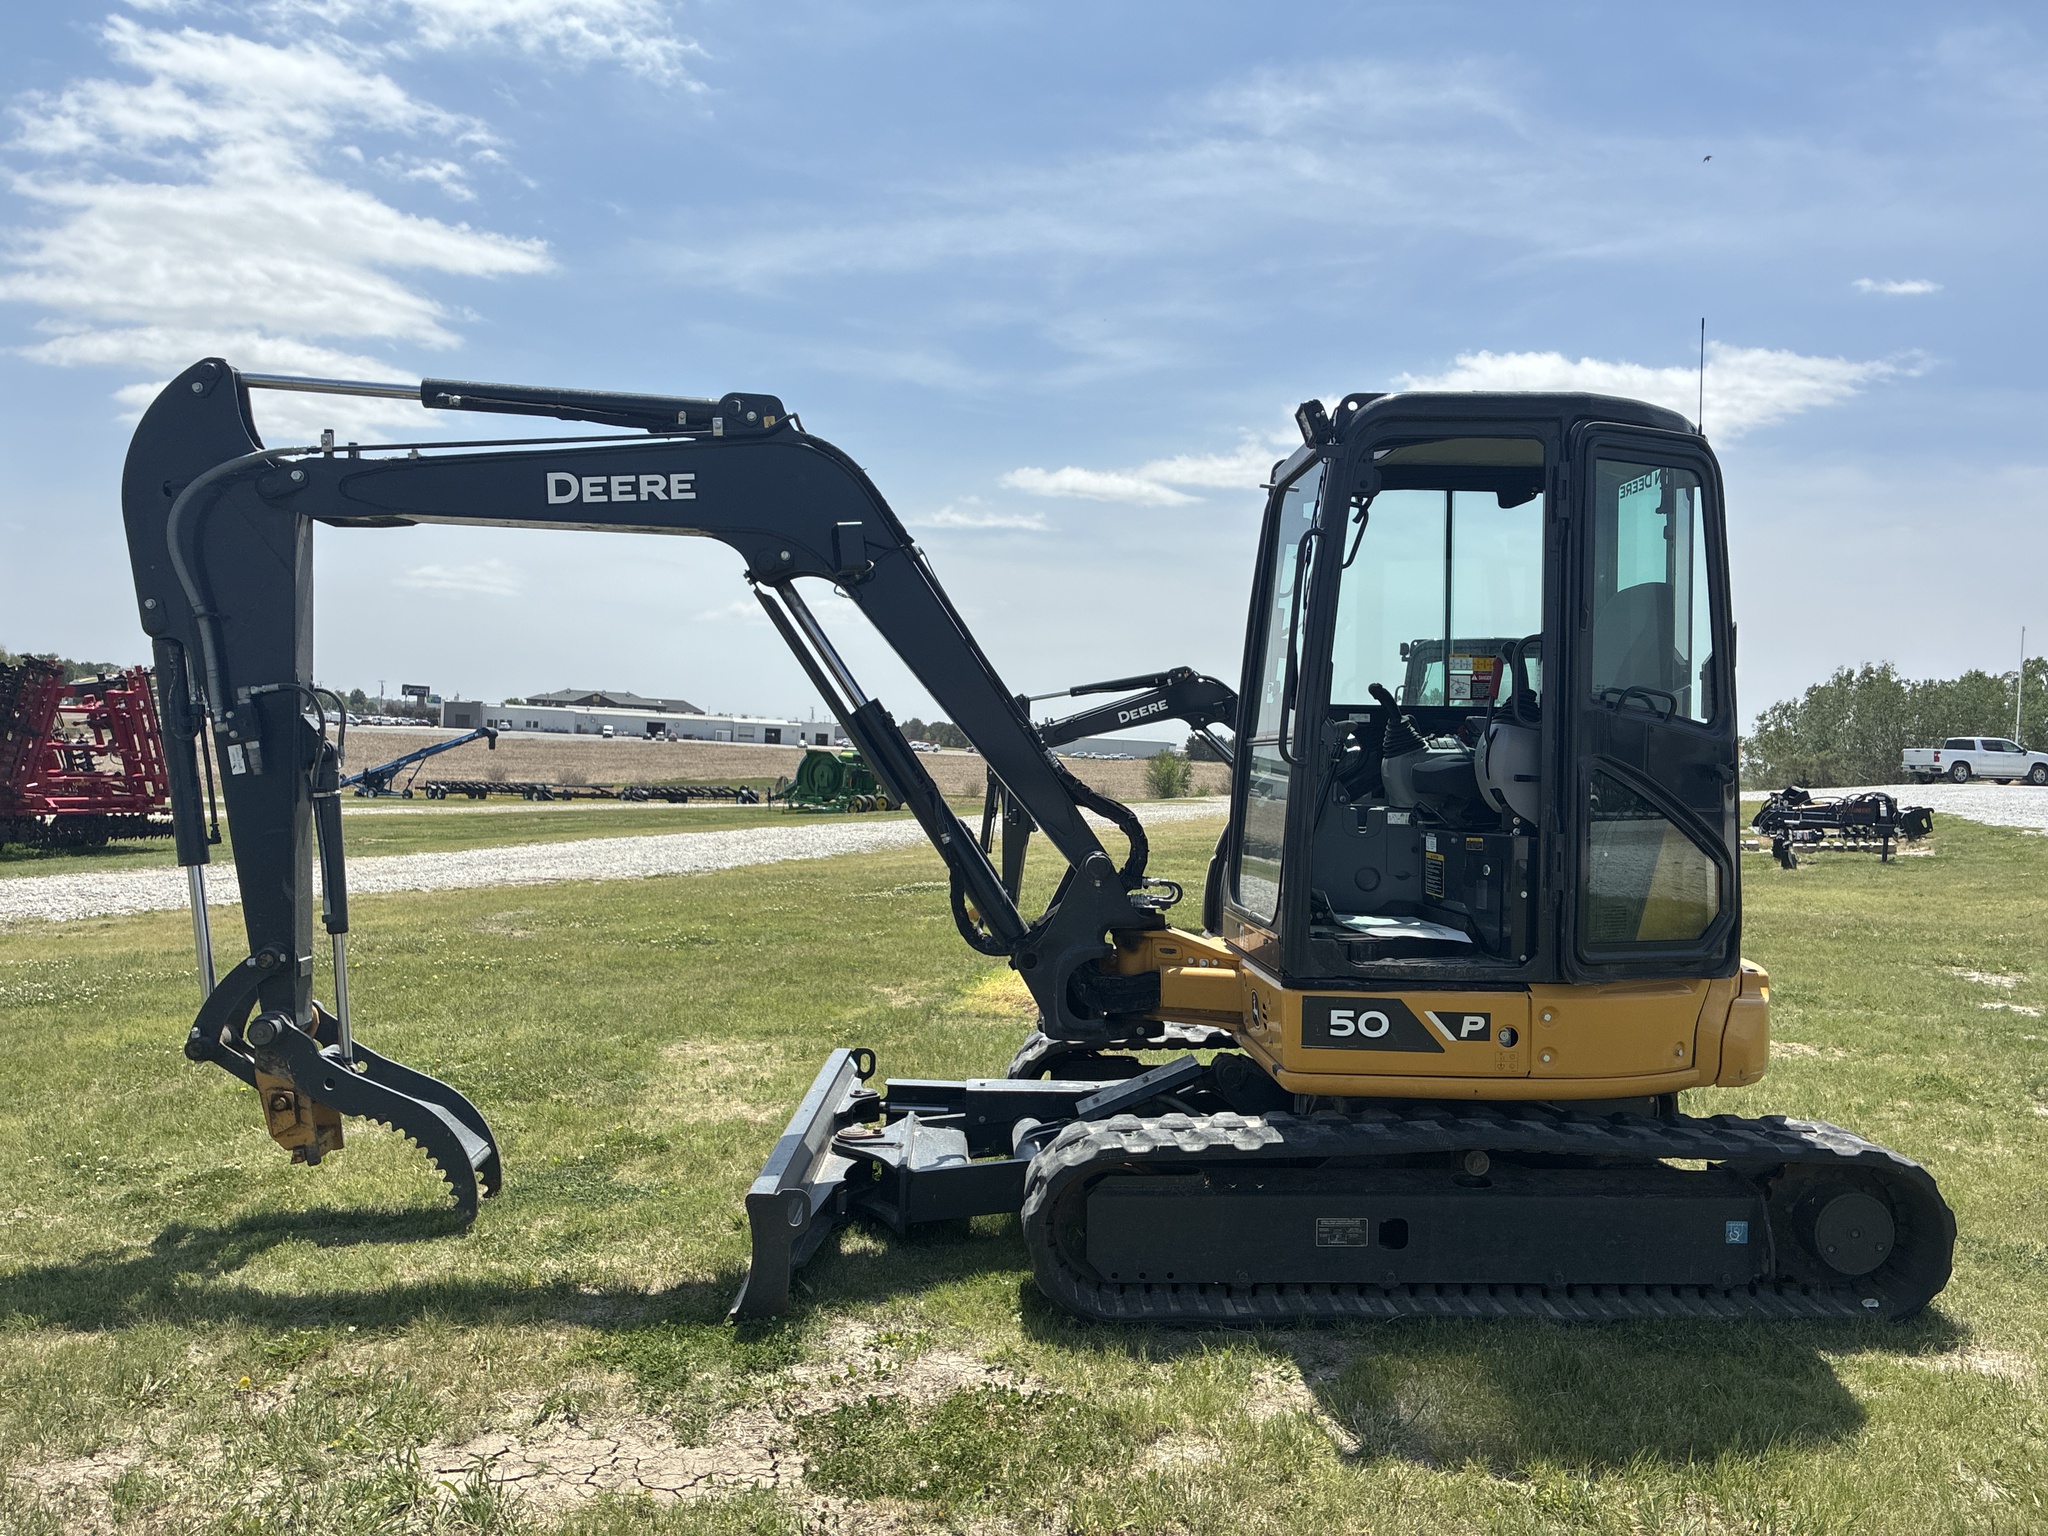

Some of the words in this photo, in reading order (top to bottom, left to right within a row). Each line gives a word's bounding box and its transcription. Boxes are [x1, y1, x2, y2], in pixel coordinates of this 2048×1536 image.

[546, 472, 696, 504] DEERE
[1118, 699, 1169, 723] DEERE
[1329, 1009, 1390, 1038] 50
[1459, 1015, 1486, 1038] P
